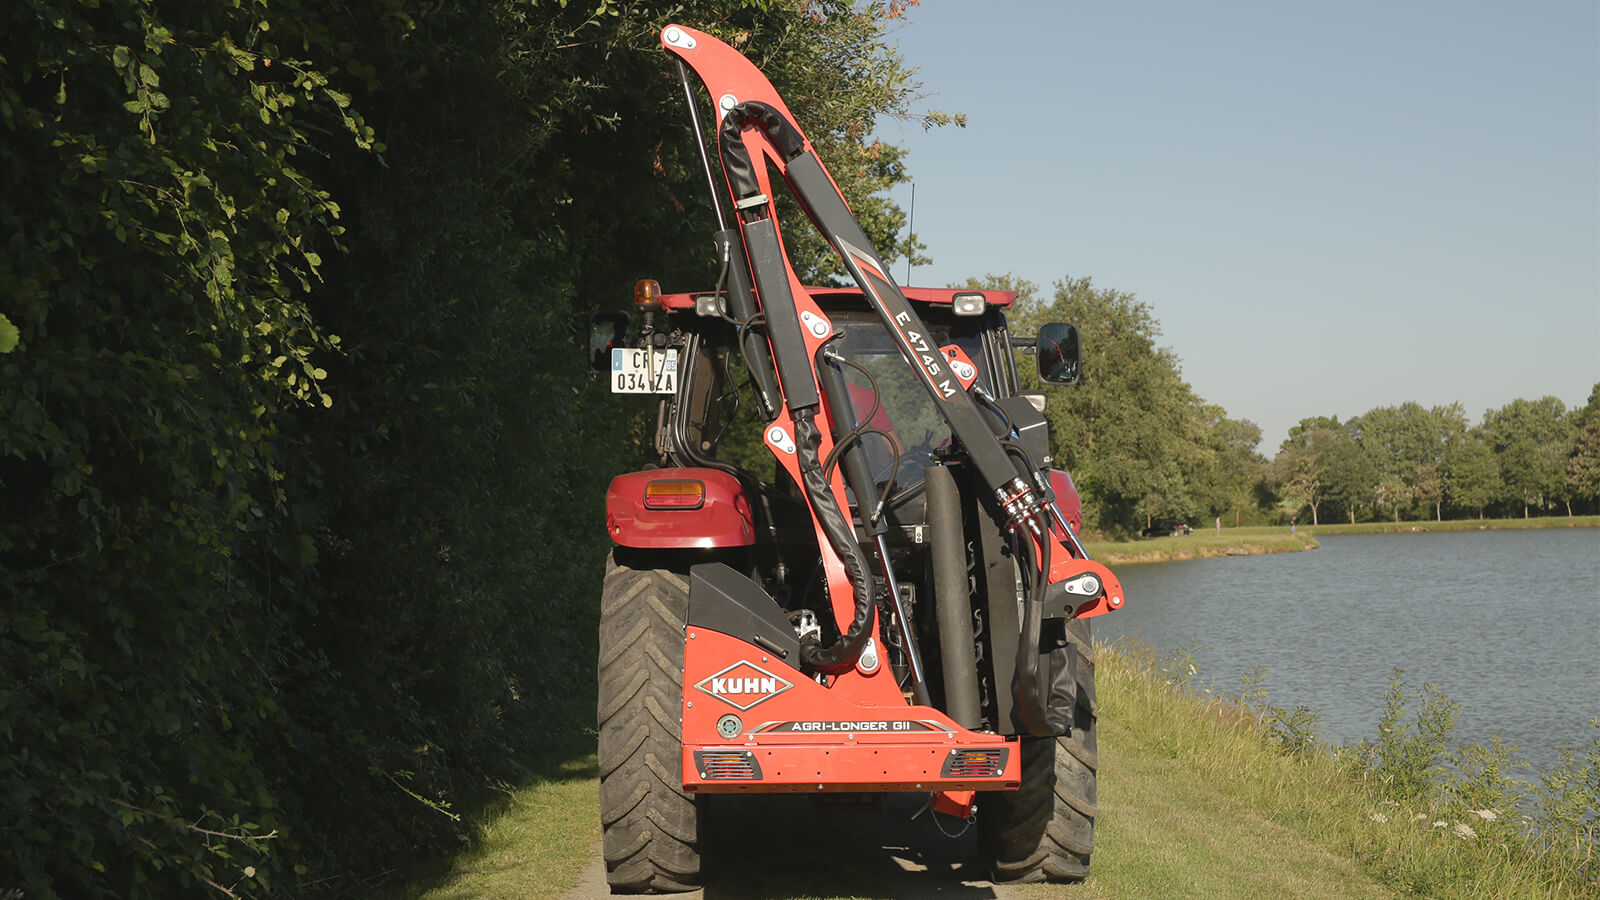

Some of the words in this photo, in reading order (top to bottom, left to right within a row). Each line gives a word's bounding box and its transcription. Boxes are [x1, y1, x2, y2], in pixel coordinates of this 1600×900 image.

[895, 311, 911, 327] E
[907, 330, 940, 376] 4745
[939, 380, 956, 398] M
[711, 677, 776, 694] KUHN
[791, 721, 888, 731] AGRI-LONGER
